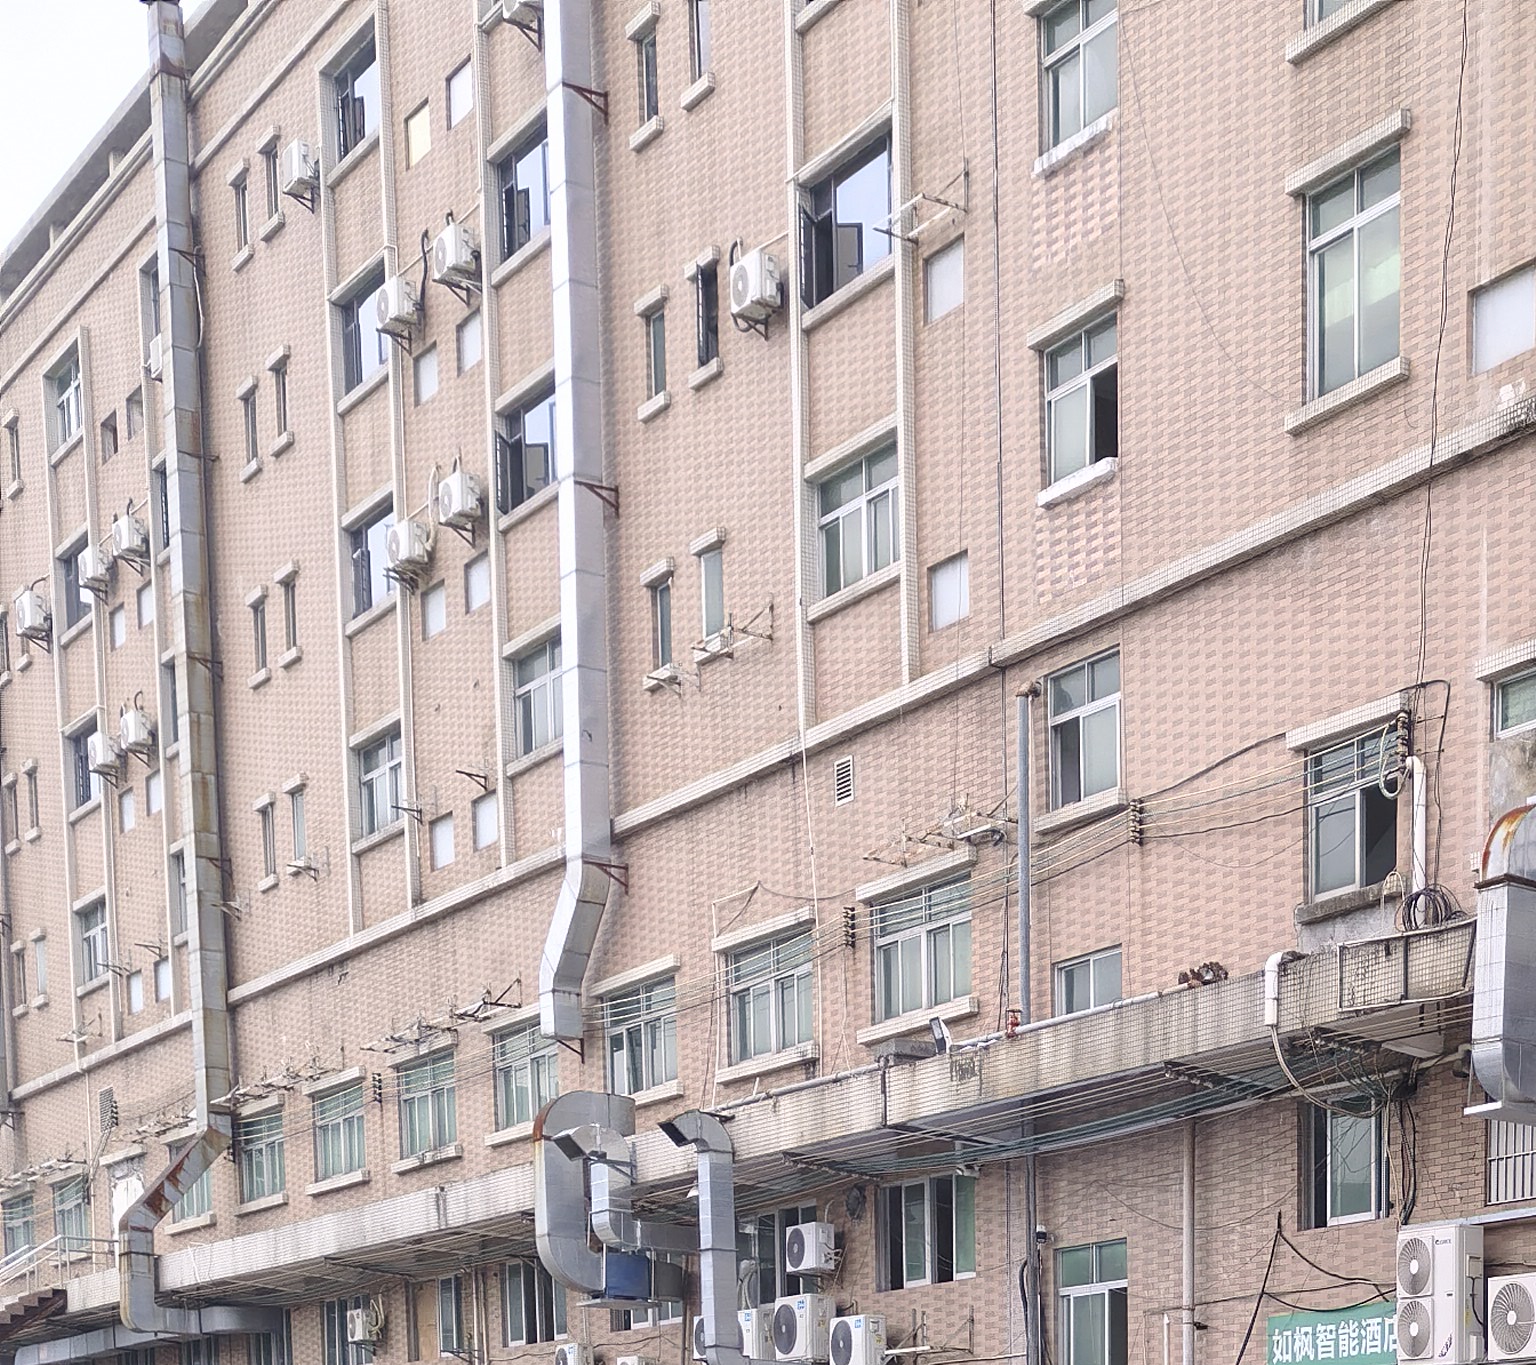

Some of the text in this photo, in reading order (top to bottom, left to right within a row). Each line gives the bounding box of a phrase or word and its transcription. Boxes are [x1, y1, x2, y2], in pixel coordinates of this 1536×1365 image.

[1272, 1313, 1398, 1364] 如枫智能酒店
